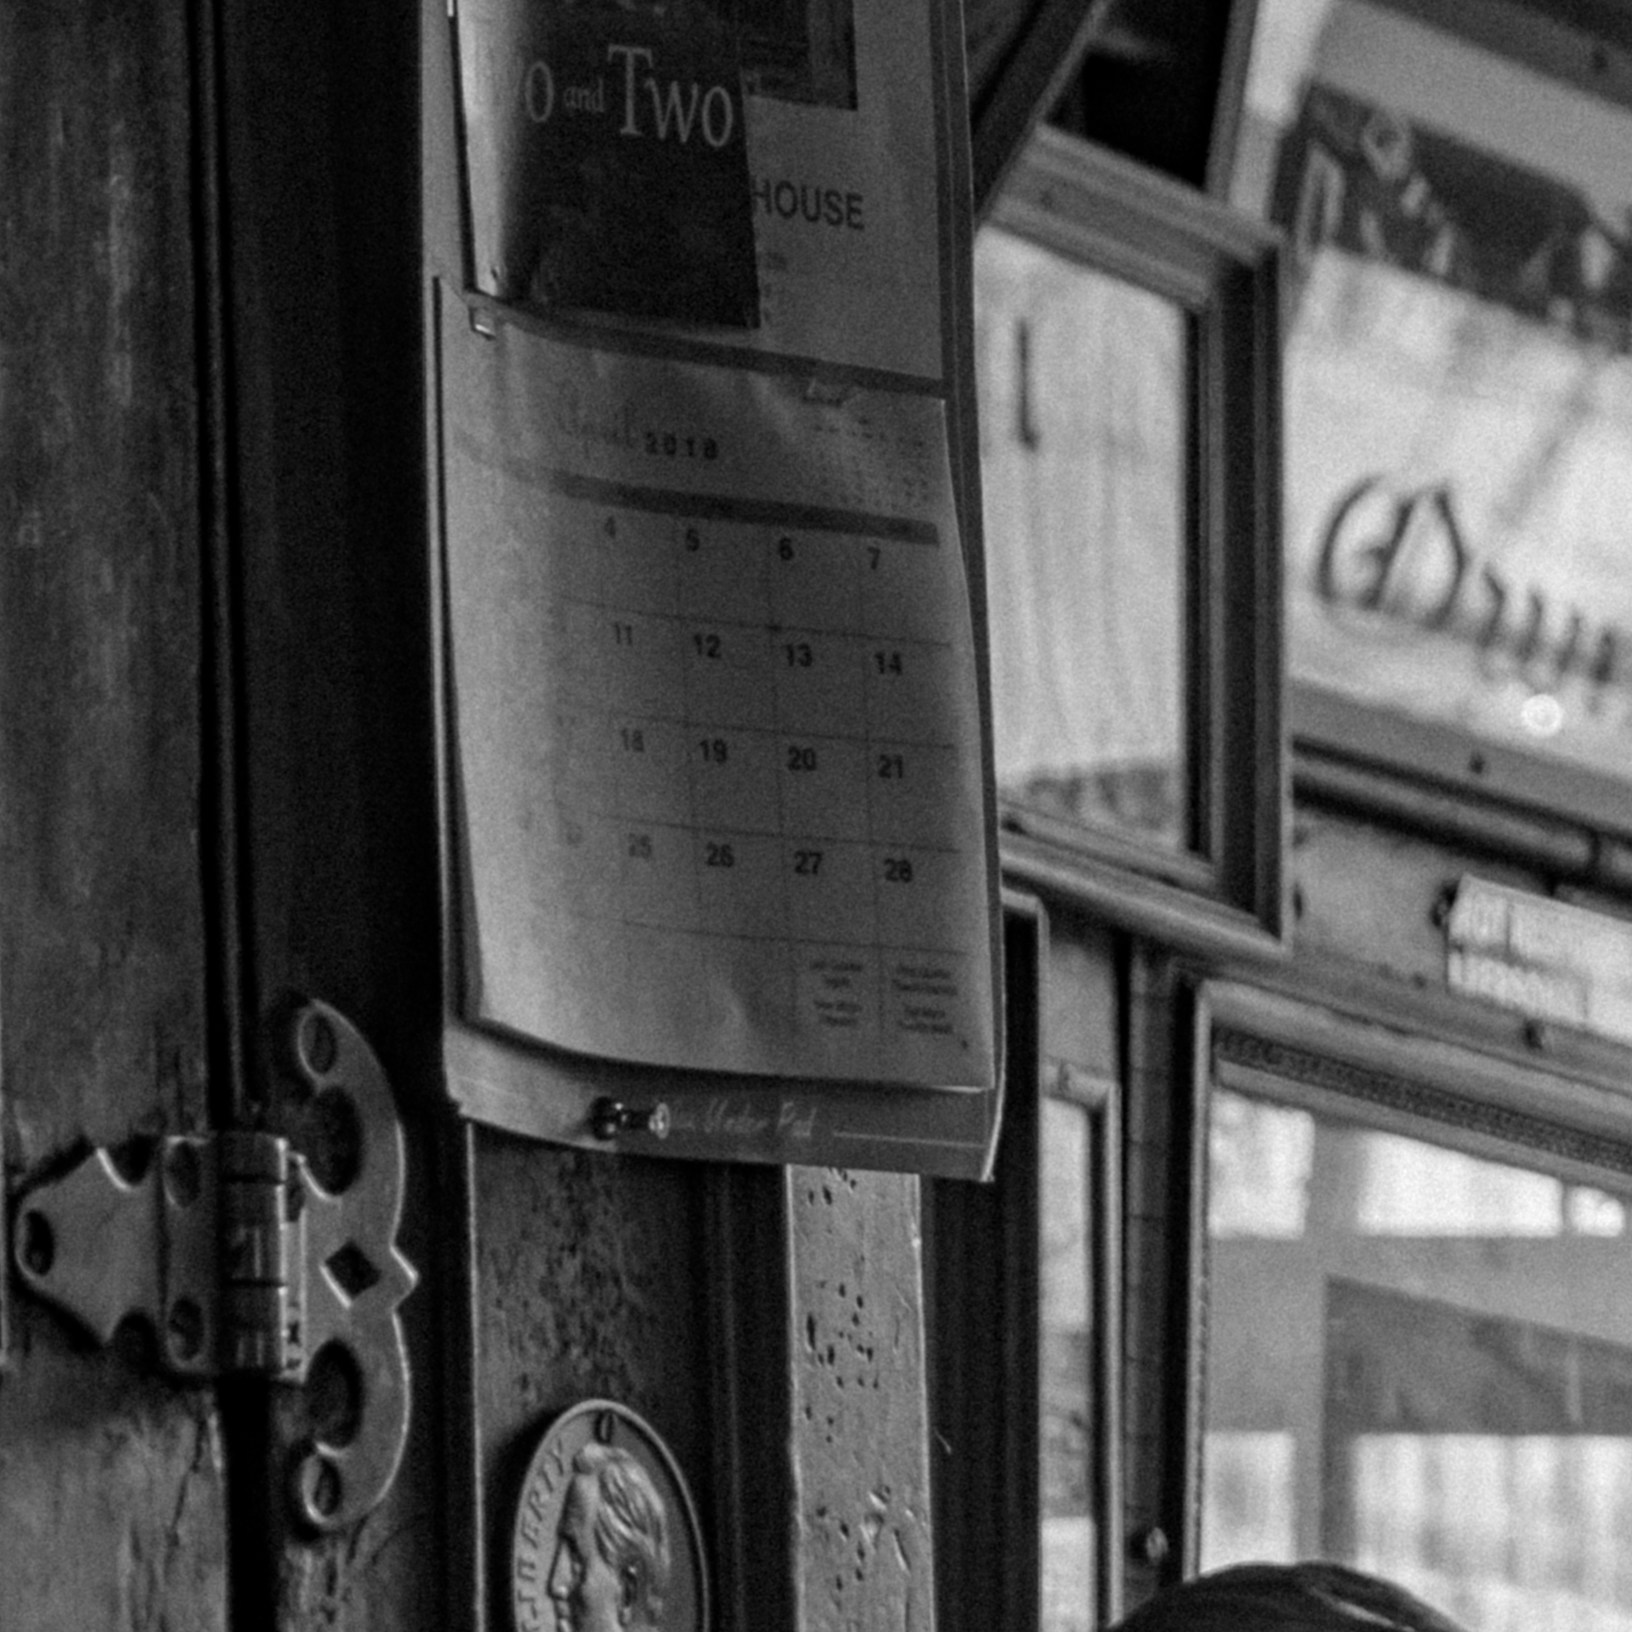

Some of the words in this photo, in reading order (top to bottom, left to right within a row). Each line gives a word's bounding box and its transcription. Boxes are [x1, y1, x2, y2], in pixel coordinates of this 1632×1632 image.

[778, 537, 794, 562] 6
[867, 546, 882, 571] 7
[613, 621, 634, 647] 11
[692, 633, 722, 660] 12
[785, 643, 814, 670] 13
[874, 650, 904, 676] 14
[699, 738, 729, 766] 19
[787, 745, 818, 773] 20
[877, 753, 907, 780] 21
[705, 841, 735, 869] 26
[793, 849, 824, 877] 27
[884, 856, 915, 885] 28
